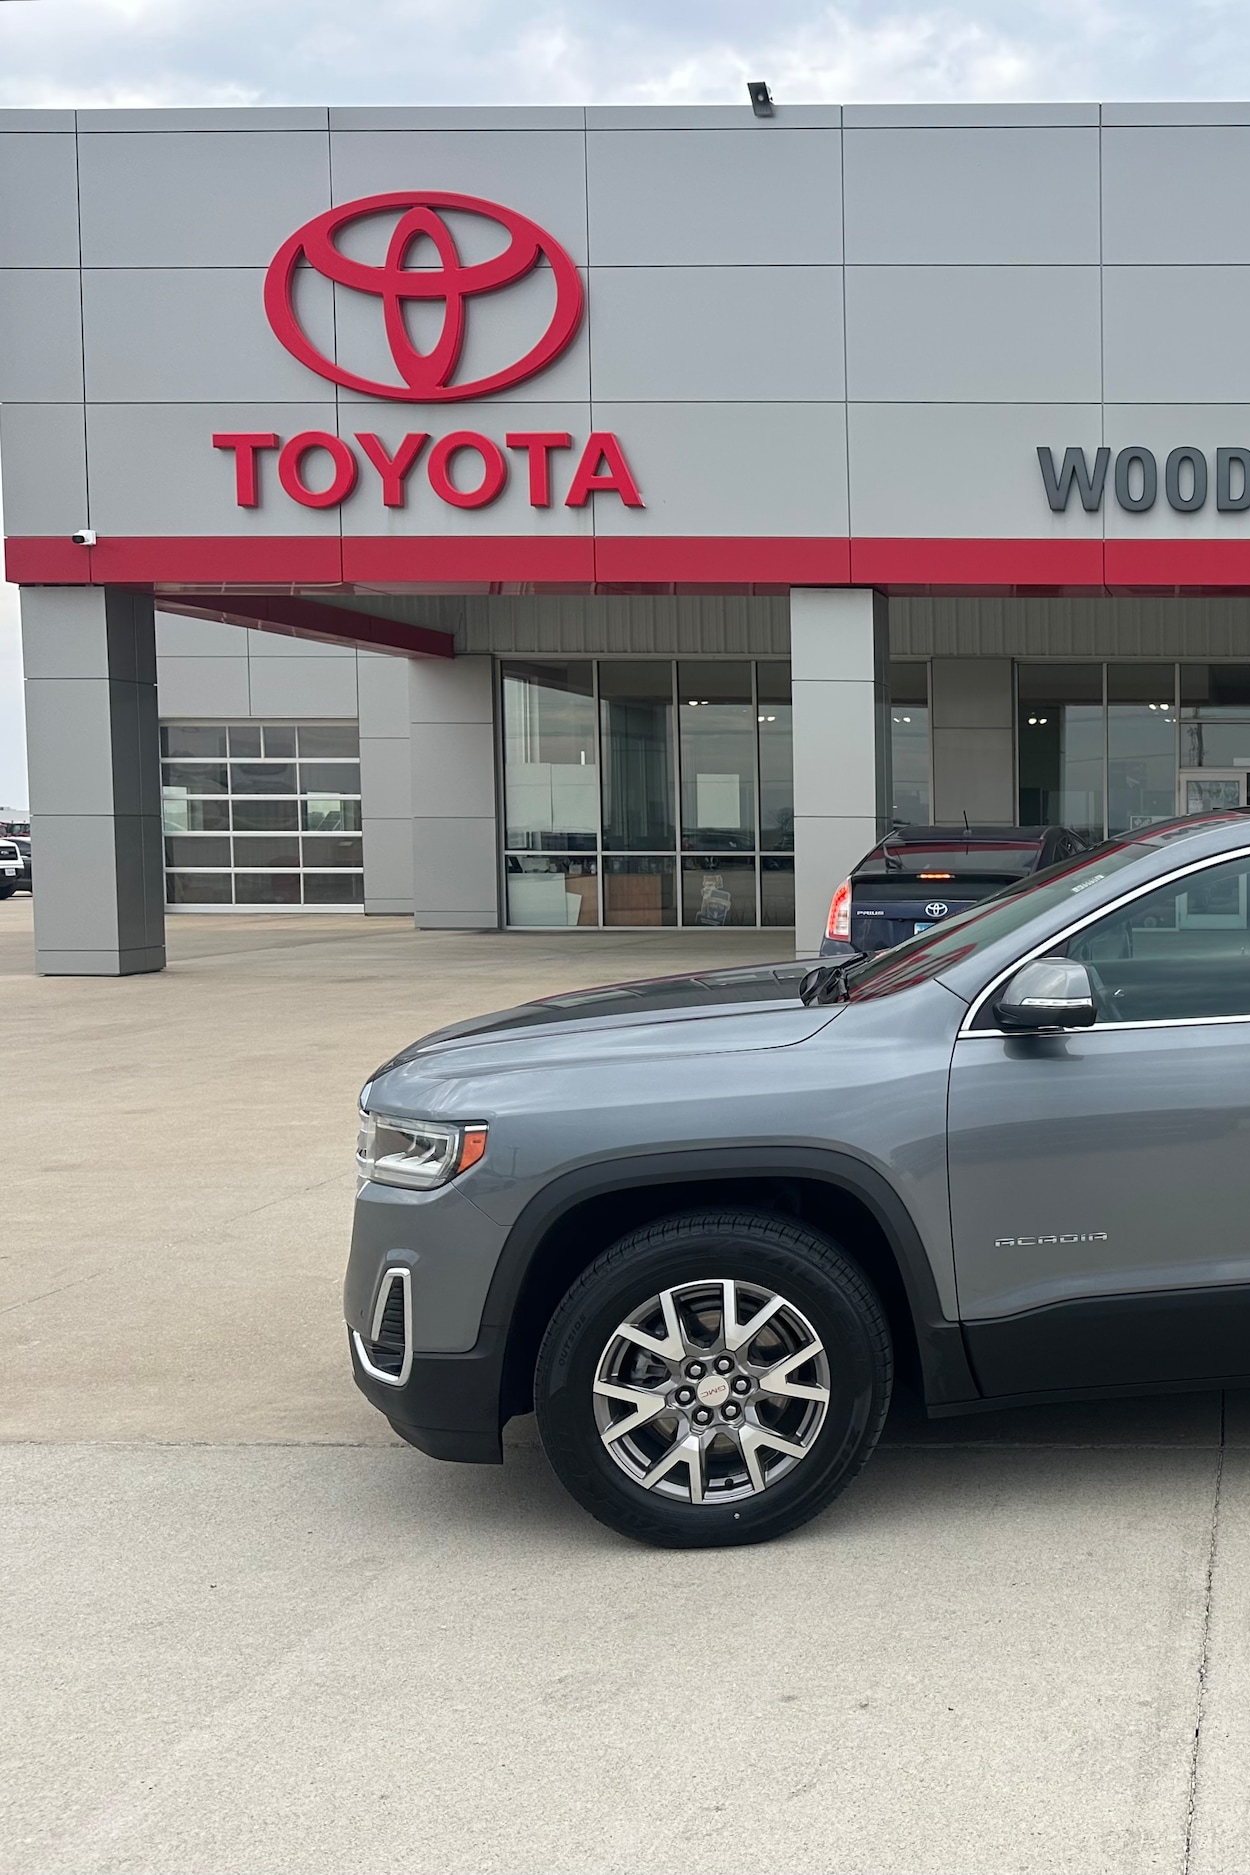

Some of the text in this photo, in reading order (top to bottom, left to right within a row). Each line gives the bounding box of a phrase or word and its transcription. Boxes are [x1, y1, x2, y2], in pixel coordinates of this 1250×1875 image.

[212, 430, 646, 508] TOYOTA
[995, 1232, 1107, 1247] ACADIA
[700, 1384, 726, 1398] GMC
